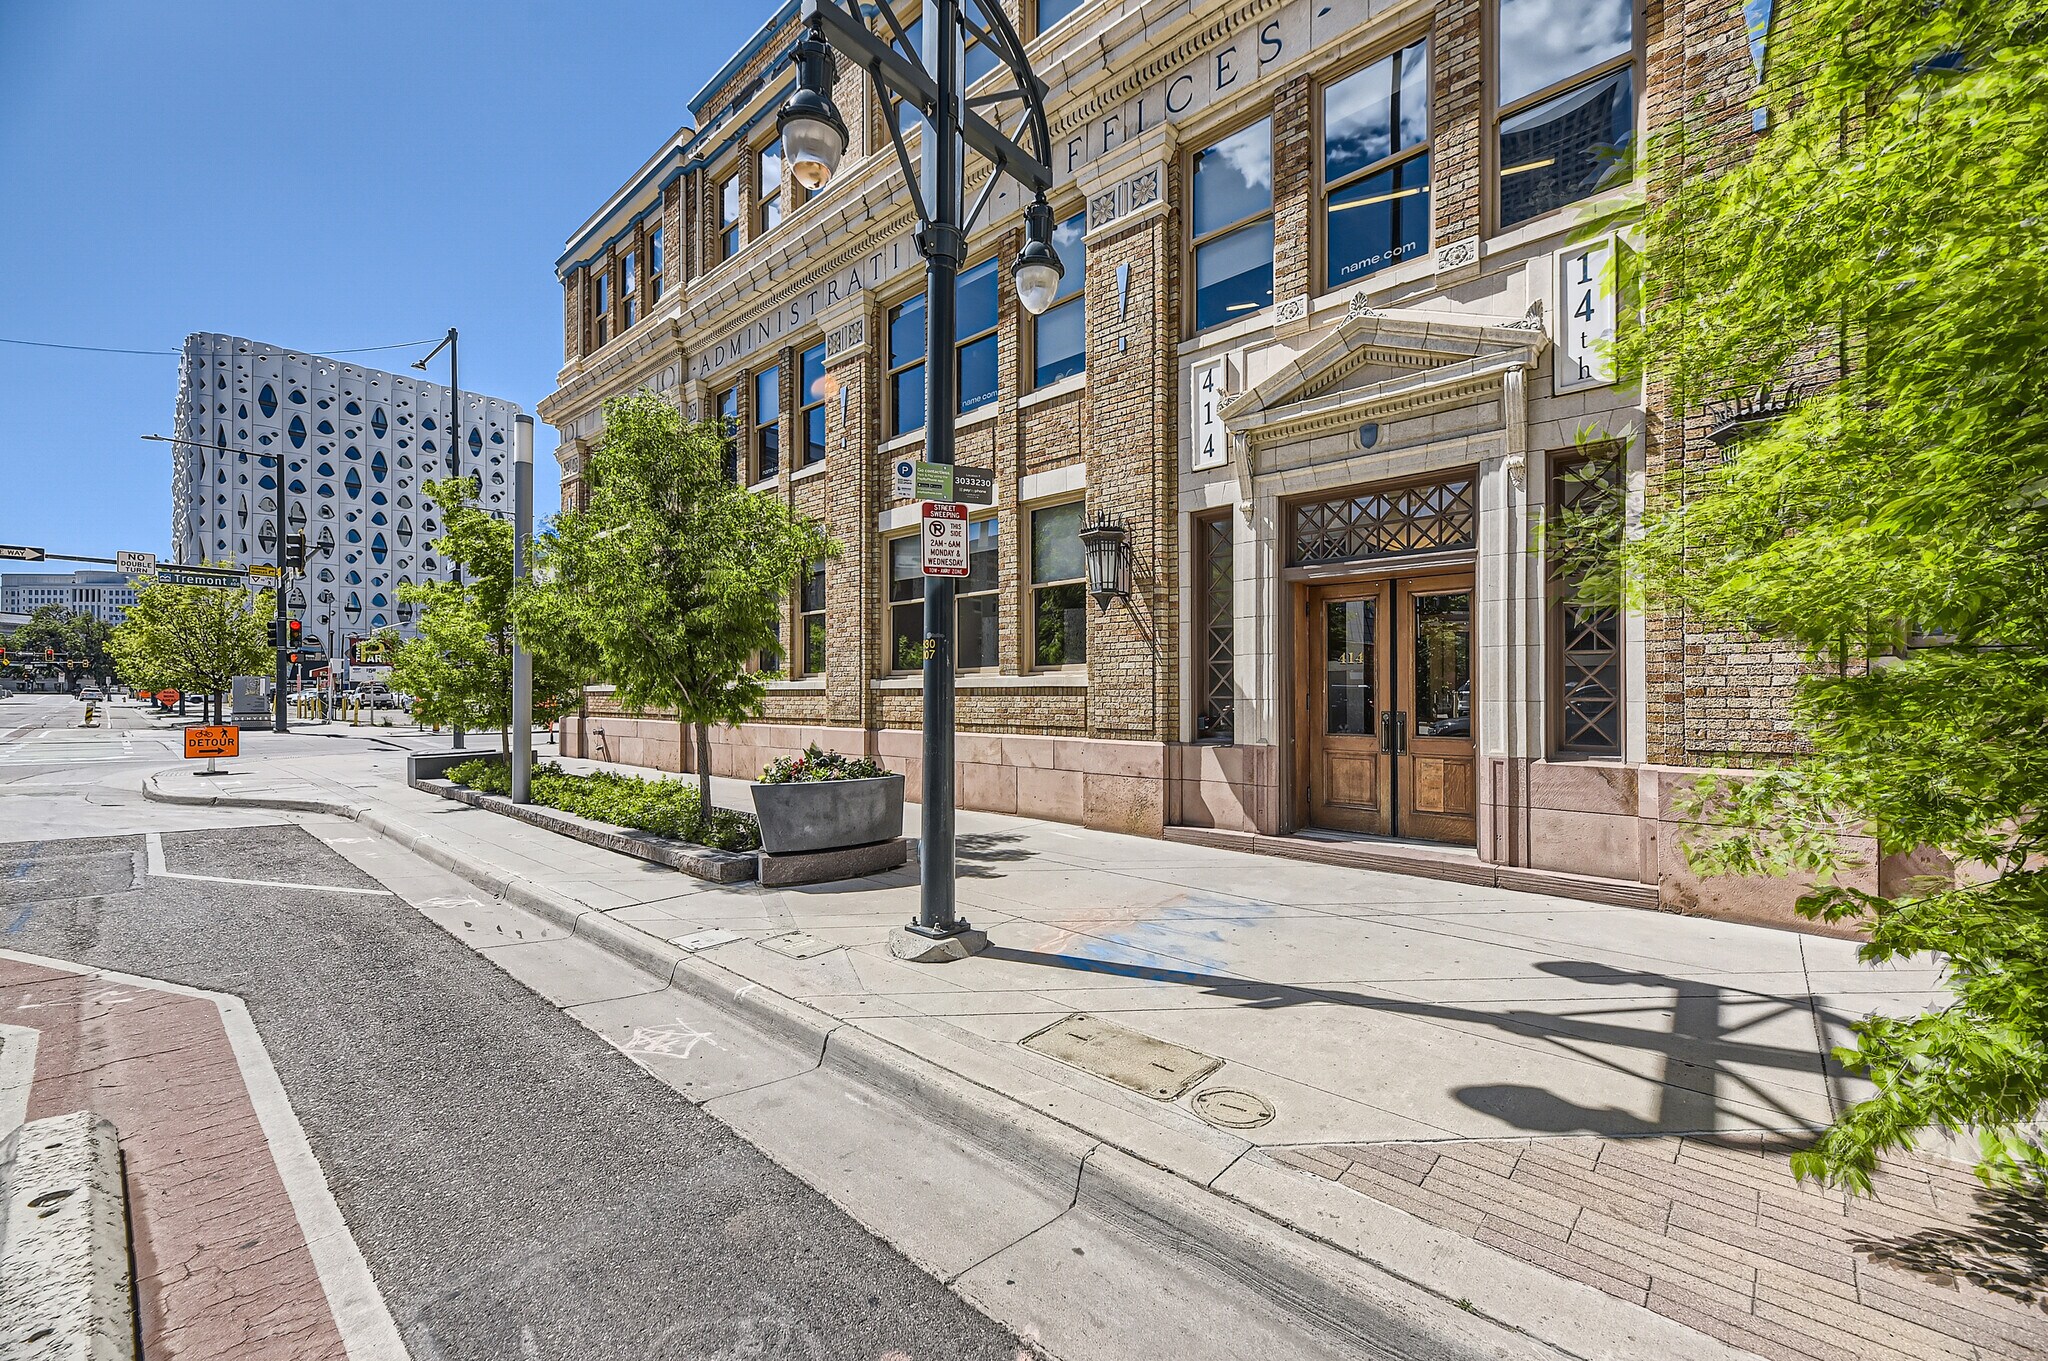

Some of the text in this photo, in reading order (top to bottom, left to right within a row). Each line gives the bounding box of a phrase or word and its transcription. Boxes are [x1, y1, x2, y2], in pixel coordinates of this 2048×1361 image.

[1066, 19, 1284, 175] FFICES
[699, 233, 922, 377] ADMINISTRATI
[1573, 251, 1596, 381] 14th
[1202, 367, 1215, 458] 414
[954, 476, 992, 488] 3033230
[934, 504, 956, 512] STREET
[930, 510, 960, 519] SWEEPING
[930, 549, 955, 557] MONDAY
[120, 560, 152, 569] DOUBLE
[928, 558, 964, 566] WEDNESDAY
[174, 574, 227, 586] Tremont
[1337, 651, 1364, 664] 414
[188, 738, 235, 748] DETOUR
